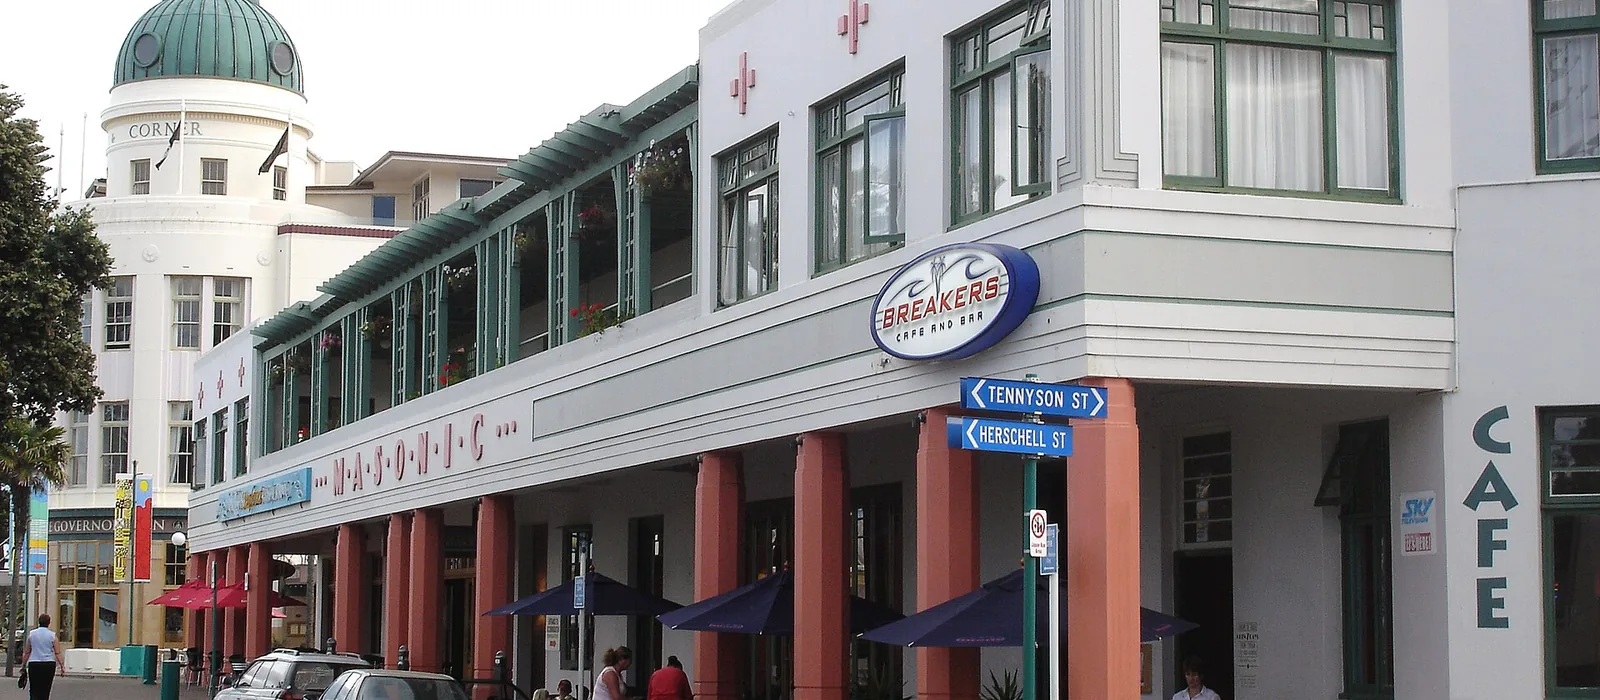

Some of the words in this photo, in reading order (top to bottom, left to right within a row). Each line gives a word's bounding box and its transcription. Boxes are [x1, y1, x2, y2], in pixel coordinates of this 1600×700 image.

[129, 121, 203, 138] CORNER
[882, 276, 1000, 329] BREAKERS
[896, 327, 924, 342] CAFE
[931, 319, 953, 334] AND
[960, 311, 984, 325] BAR
[988, 385, 1064, 408] TENNYSON
[1072, 391, 1089, 410] ST
[979, 425, 1046, 447] HERSCHELL
[1052, 431, 1067, 449] ST
[1402, 498, 1434, 517] SKY
[1462, 405, 1519, 629] CAFE
[54, 519, 116, 532] GOVERNO
